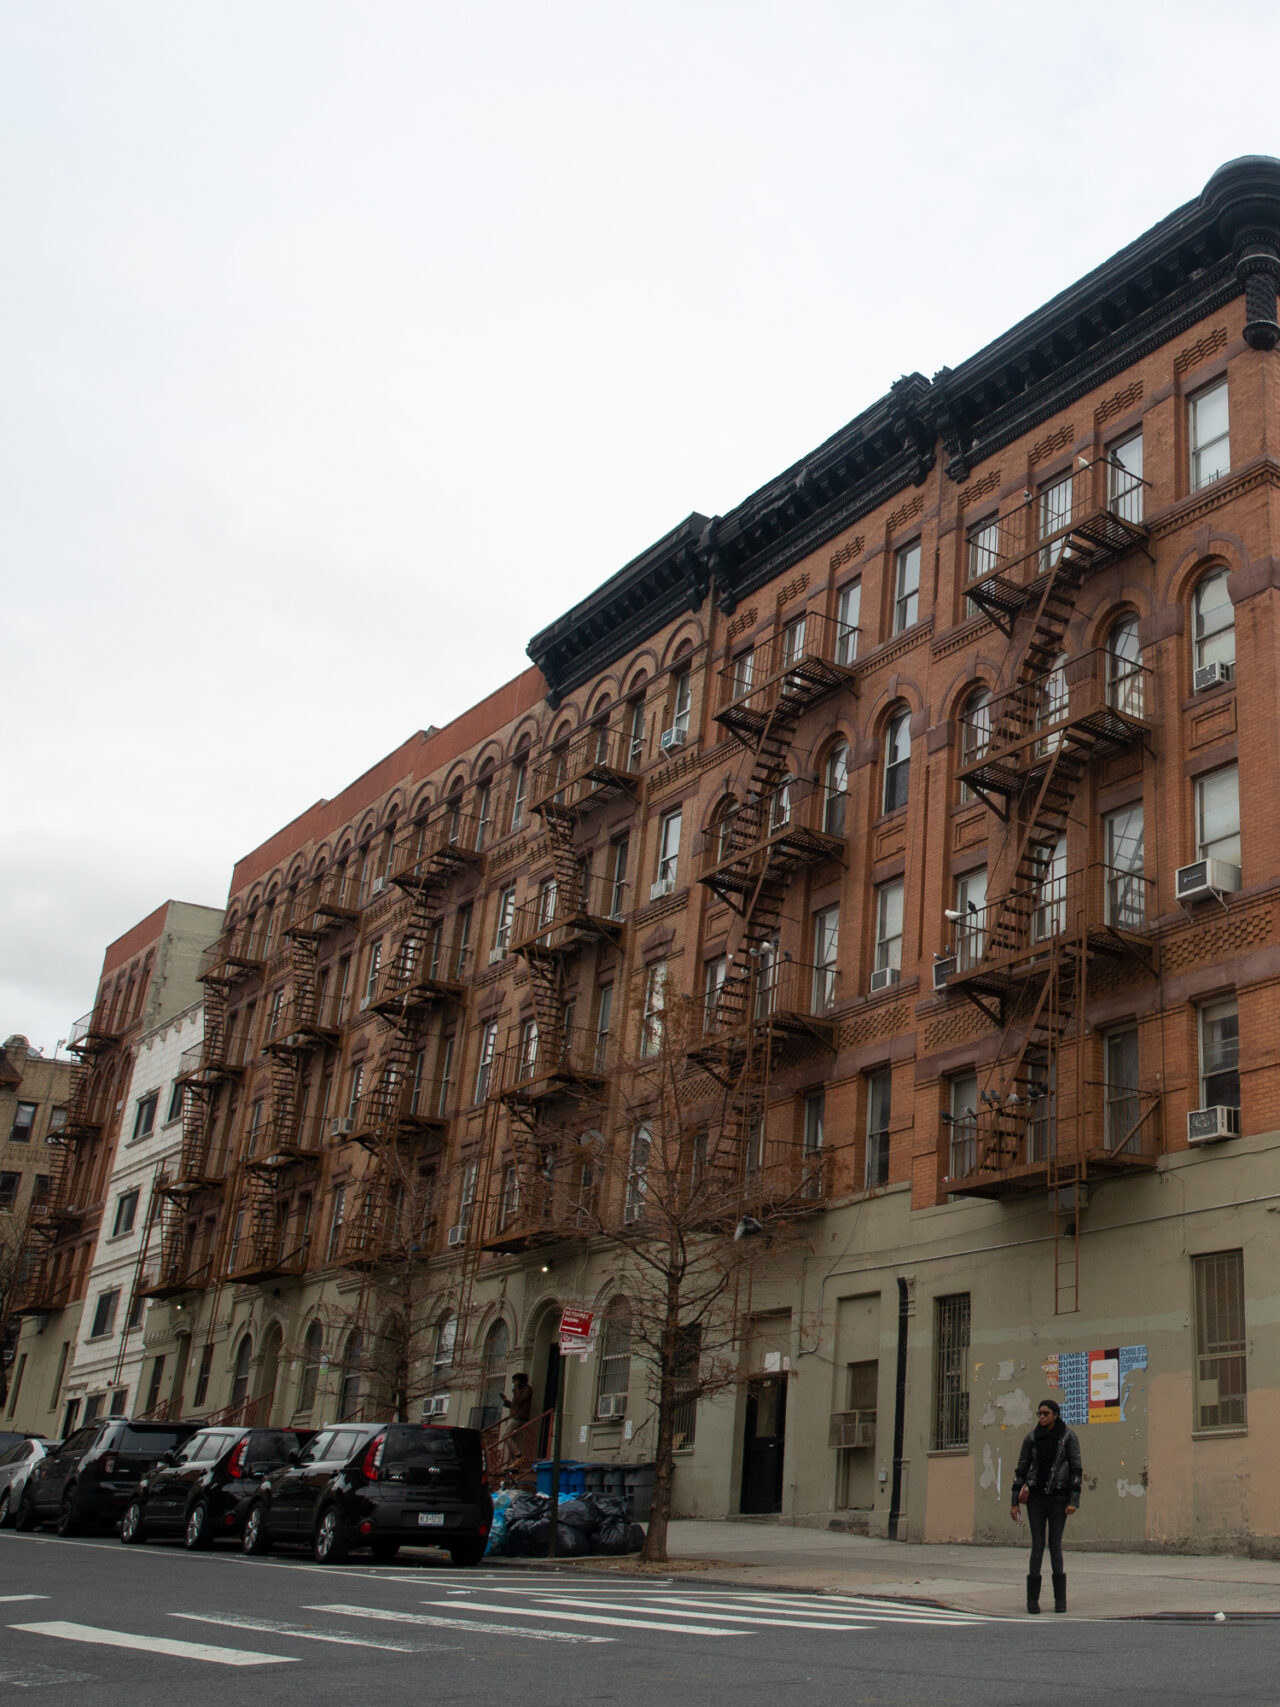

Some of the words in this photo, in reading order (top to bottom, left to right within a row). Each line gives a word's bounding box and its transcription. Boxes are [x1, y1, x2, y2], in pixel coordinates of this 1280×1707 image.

[1058, 1352, 1089, 1361] BUMBLE
[1058, 1358, 1089, 1368] BUMBLE
[1058, 1366, 1089, 1376] BUMBLE
[1058, 1373, 1089, 1383] BUMBLE
[1064, 1388, 1089, 1397] UMBLE
[1064, 1395, 1089, 1404] UMBLE
